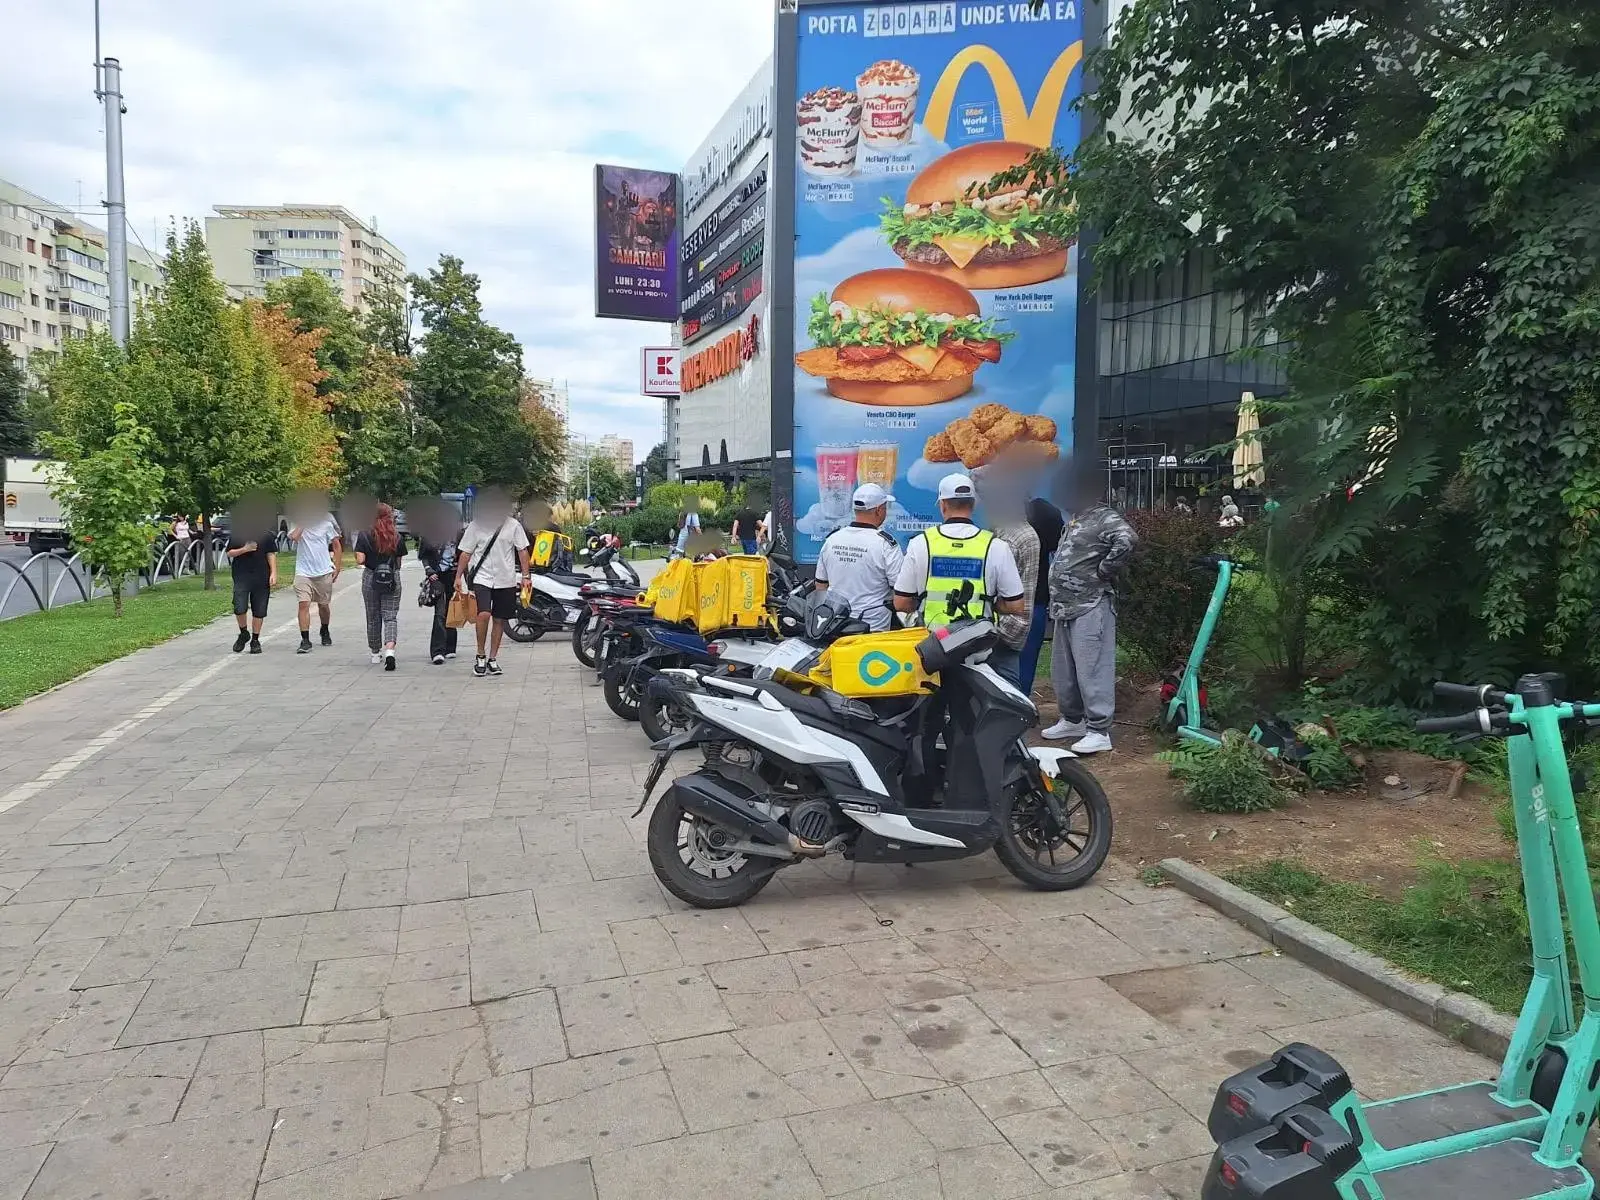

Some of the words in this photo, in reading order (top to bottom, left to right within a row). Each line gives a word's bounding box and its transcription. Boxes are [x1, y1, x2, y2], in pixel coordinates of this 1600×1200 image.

[808, 15, 857, 34] POFTA
[864, 5, 956, 35] ZBOARĂ
[961, 8, 1009, 26] UNDE
[1055, 1, 1076, 20] EA
[866, 101, 908, 112] McFlurry
[962, 116, 988, 126] World
[807, 127, 851, 138] McFlurry
[965, 126, 985, 135] Tour
[680, 212, 718, 262] RESERVED
[615, 276, 633, 286] LUNI
[637, 277, 661, 289] 23:30
[1018, 302, 1054, 312] AMERICA
[743, 575, 753, 610] Glovo
[1531, 783, 1548, 825] Bolt
